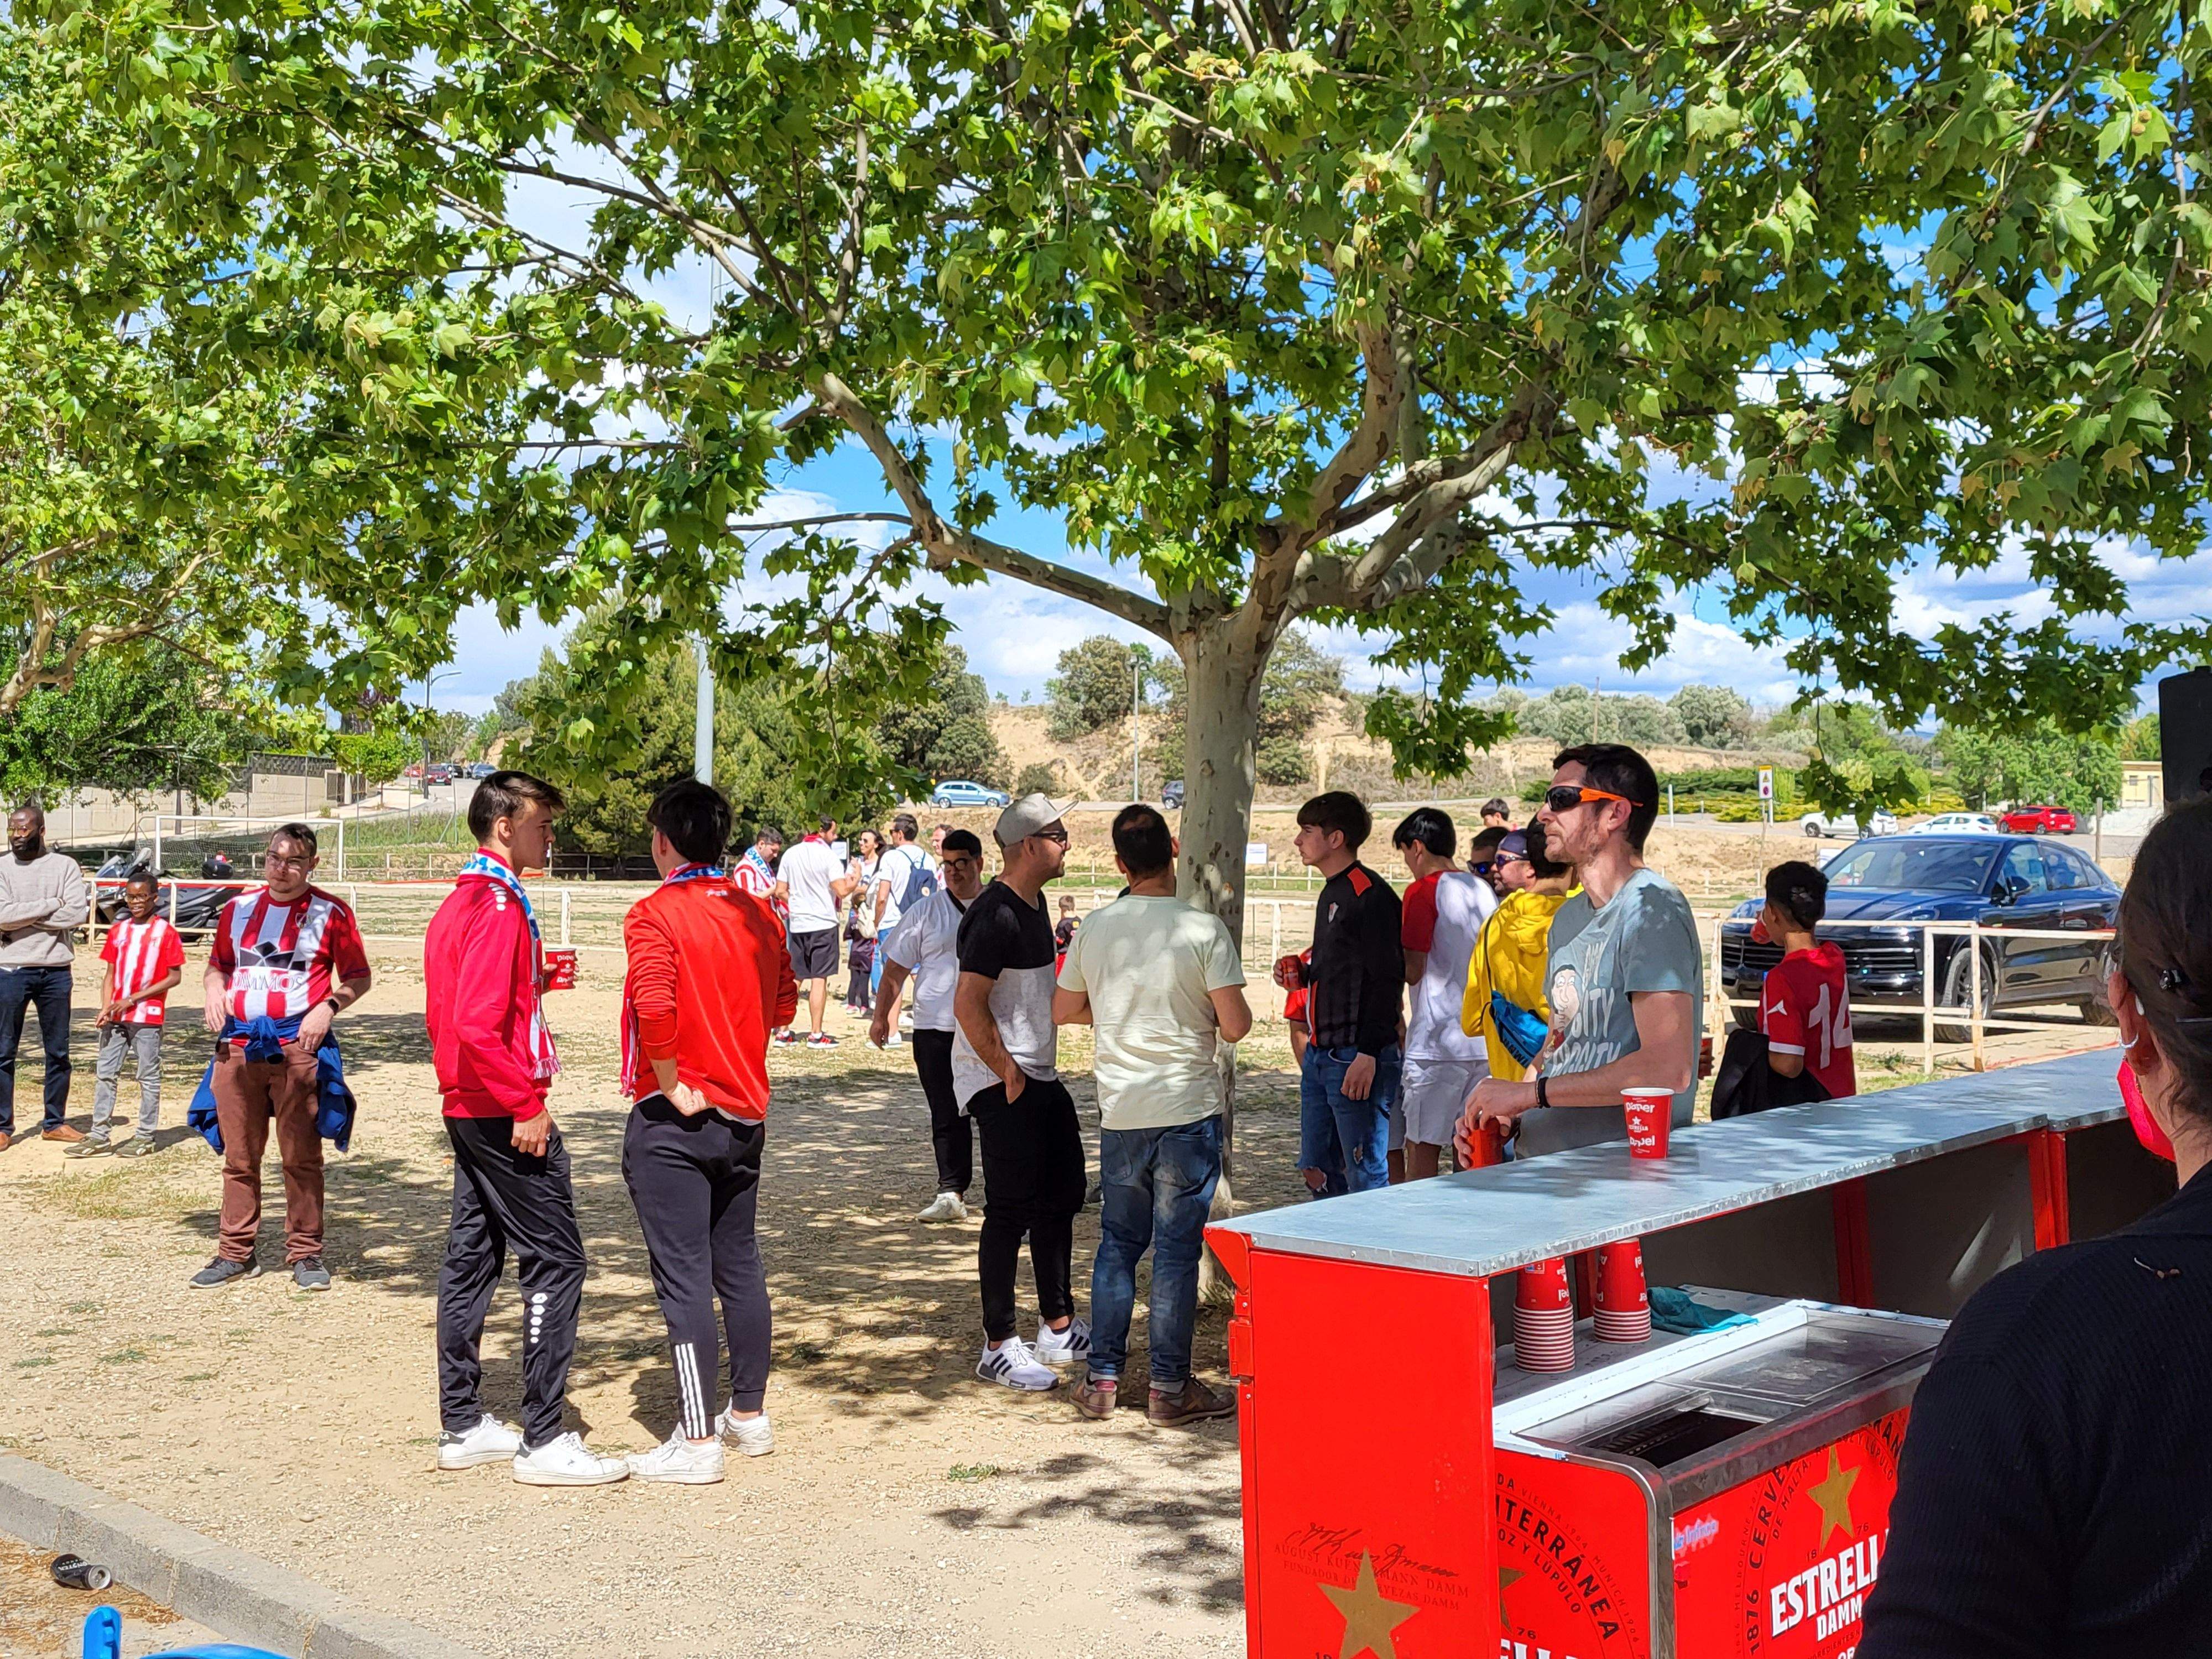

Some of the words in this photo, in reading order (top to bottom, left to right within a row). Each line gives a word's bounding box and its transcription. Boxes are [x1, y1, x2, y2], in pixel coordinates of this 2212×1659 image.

[1522, 1488, 1562, 1522] VIENNA
[1593, 1554, 1627, 1606] MUNICH
[1772, 1517, 1783, 1540] DE
[1806, 1549, 1817, 1562] 18
[1856, 1522, 1869, 1536] 76
[1275, 1543, 1319, 1563] AUGUST
[1427, 1578, 1469, 1598] DAMM
[1284, 1559, 1338, 1582] FUNDADOR
[1424, 1594, 1459, 1611] DAMM
[1521, 1541, 1531, 1554] Y
[1534, 1554, 1582, 1614] LÚPULO
[1734, 1519, 1751, 1611] MELBOURNE
[1516, 1626, 1537, 1640] 76
[1746, 1590, 1760, 1656] 1876
[1817, 1593, 1863, 1641] DAMM
